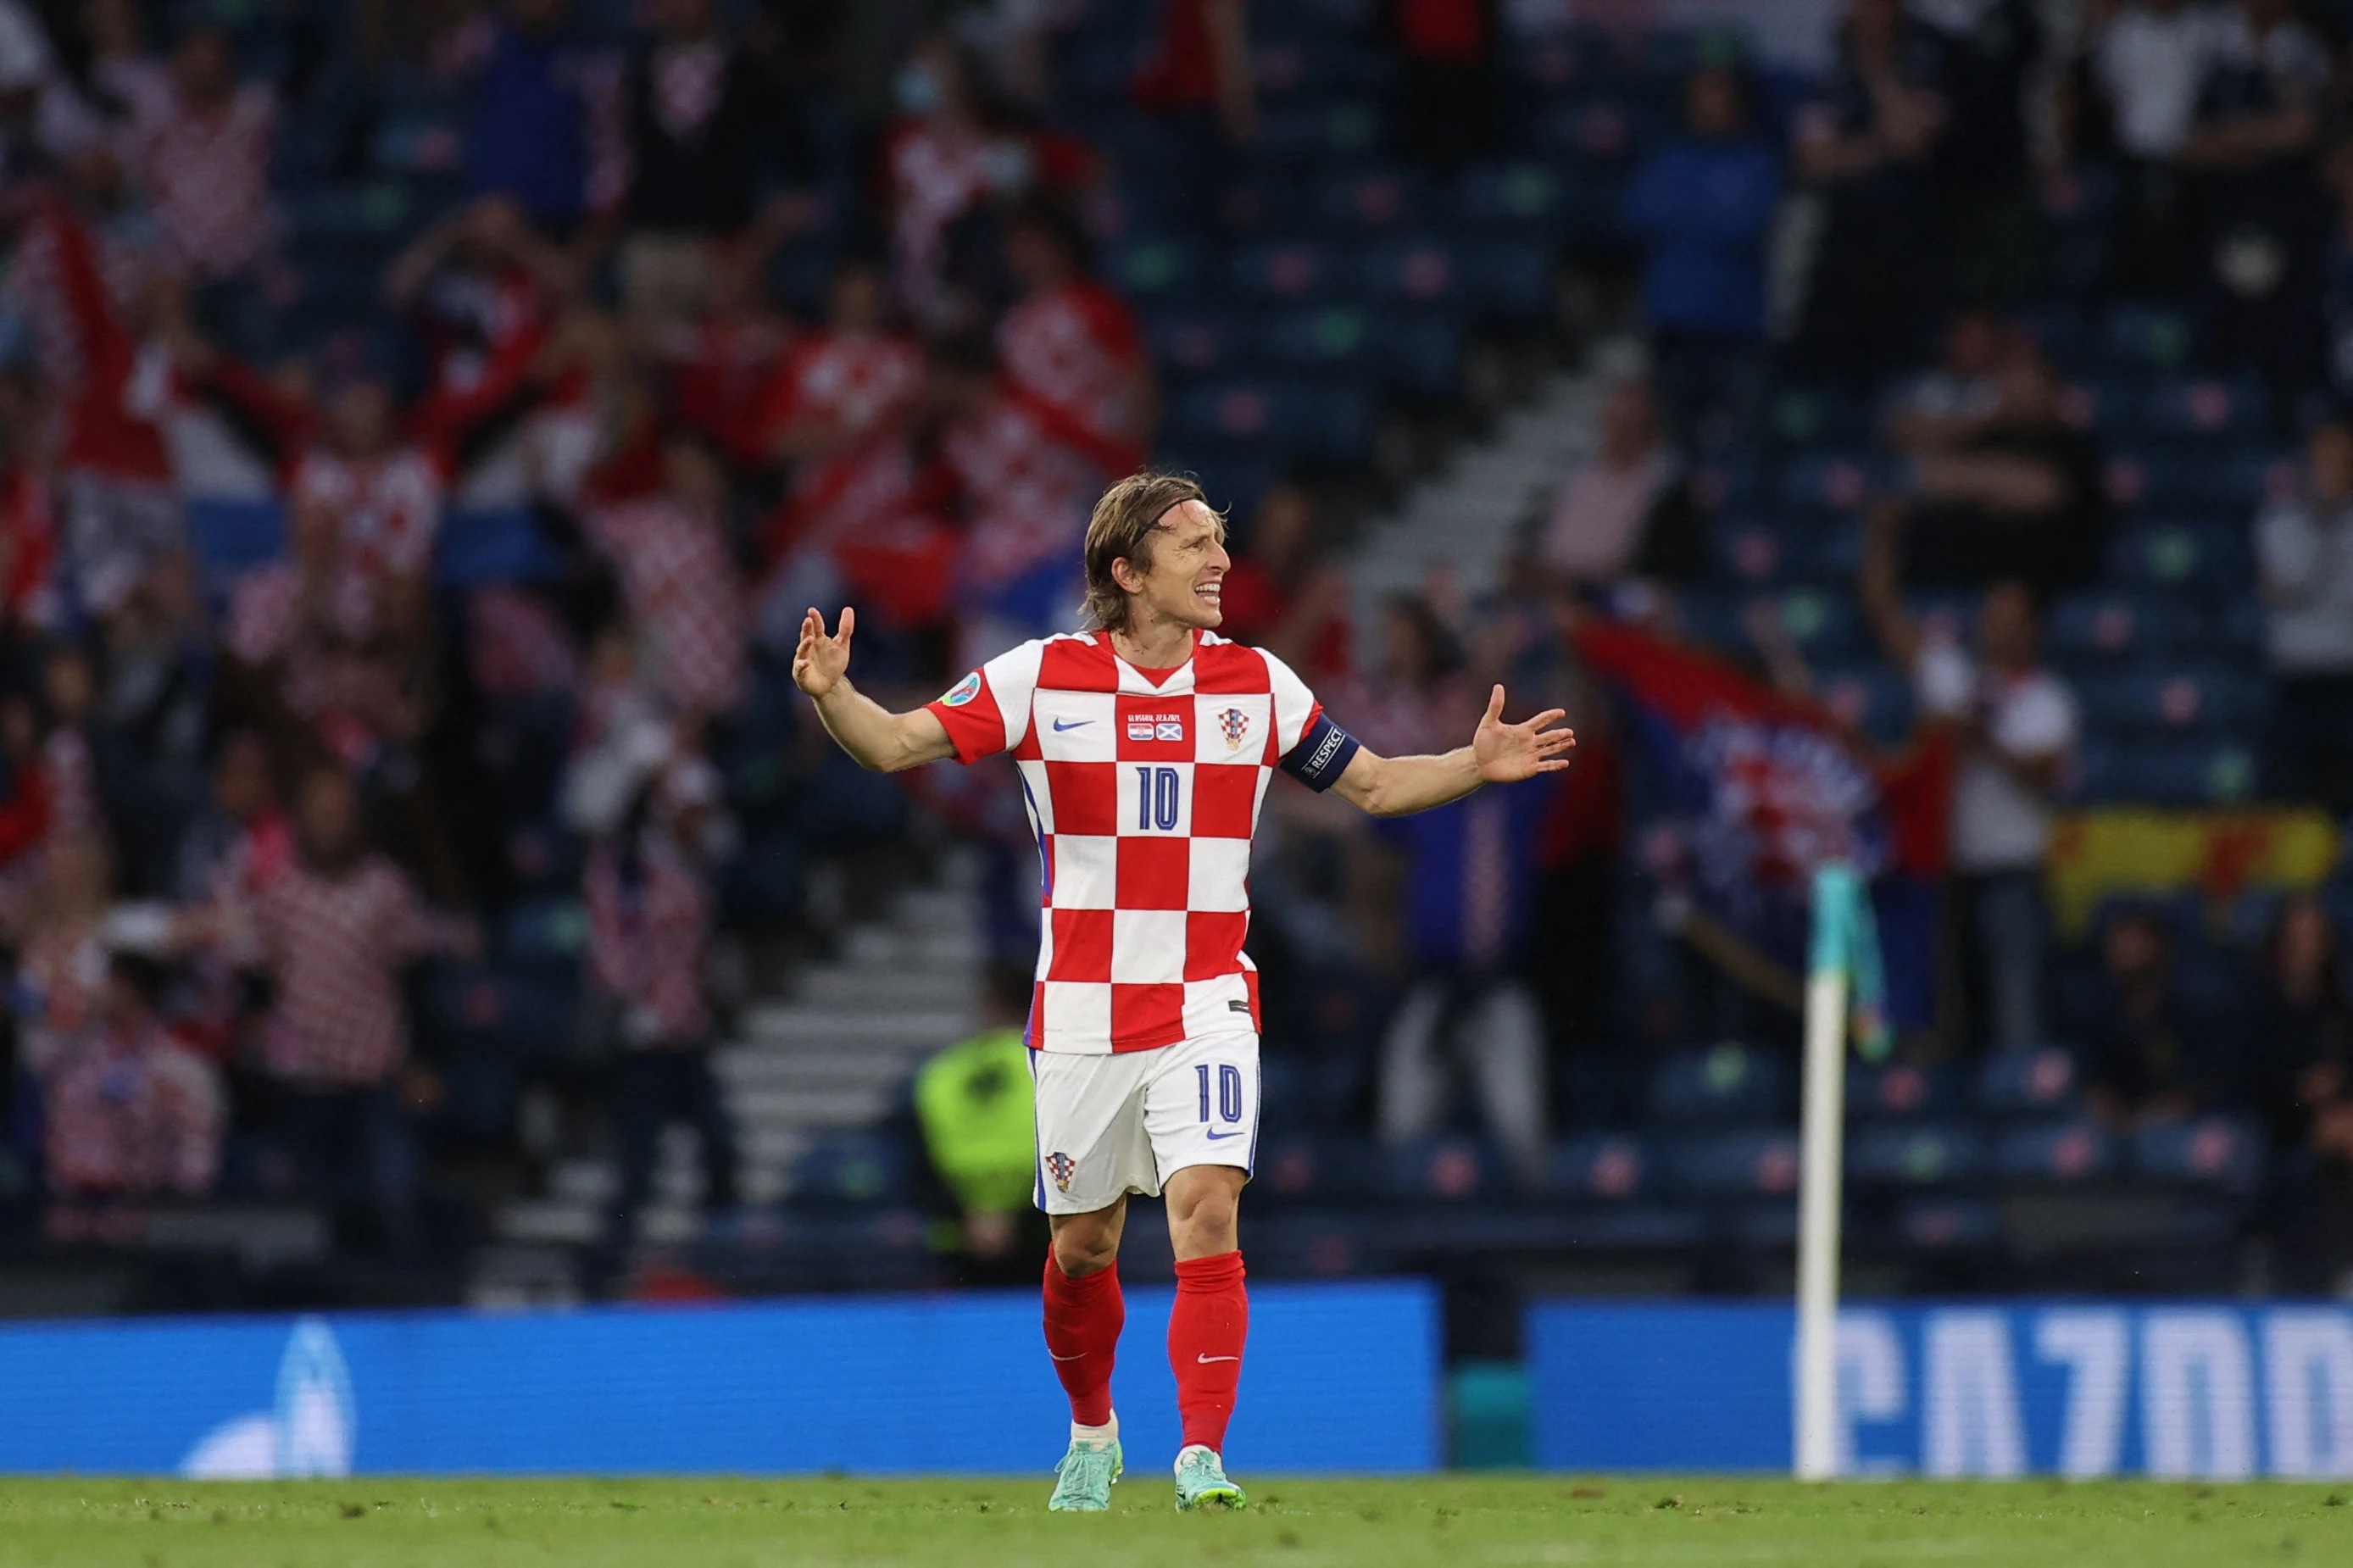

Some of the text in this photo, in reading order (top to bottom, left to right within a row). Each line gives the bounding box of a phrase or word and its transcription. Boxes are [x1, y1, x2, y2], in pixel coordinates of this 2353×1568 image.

[1311, 728, 1343, 769] RESPECT
[1135, 766, 1179, 831] 10
[1194, 1064, 1242, 1123] 10
